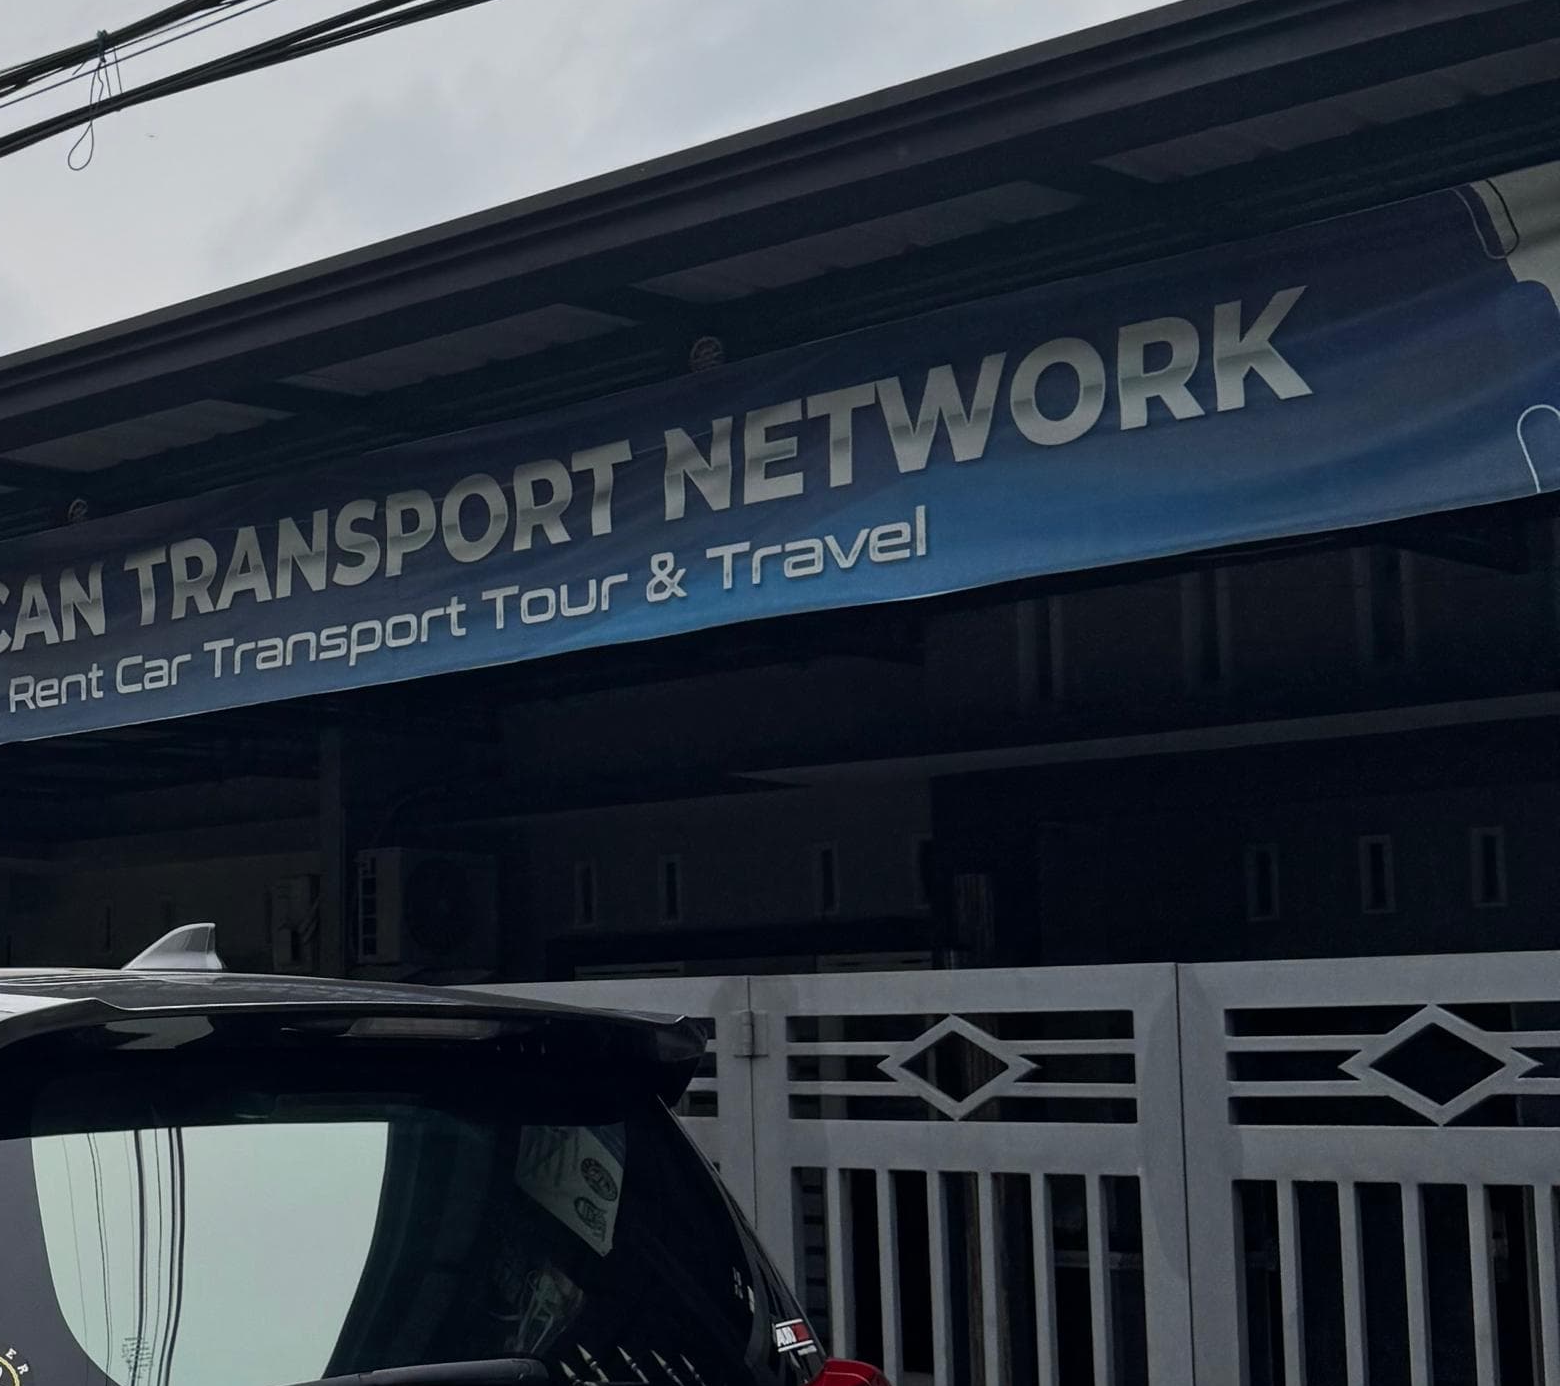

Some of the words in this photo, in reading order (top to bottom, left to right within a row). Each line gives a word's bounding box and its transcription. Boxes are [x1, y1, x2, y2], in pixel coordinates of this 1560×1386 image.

[124, 440, 632, 626] TRANSPORT
[664, 285, 1313, 521] NETWORK
[9, 663, 104, 714] Rent
[115, 653, 192, 694] Car
[203, 596, 466, 667] Transport
[482, 573, 628, 630] Tour
[645, 552, 687, 603] &
[706, 505, 927, 592] Travel
